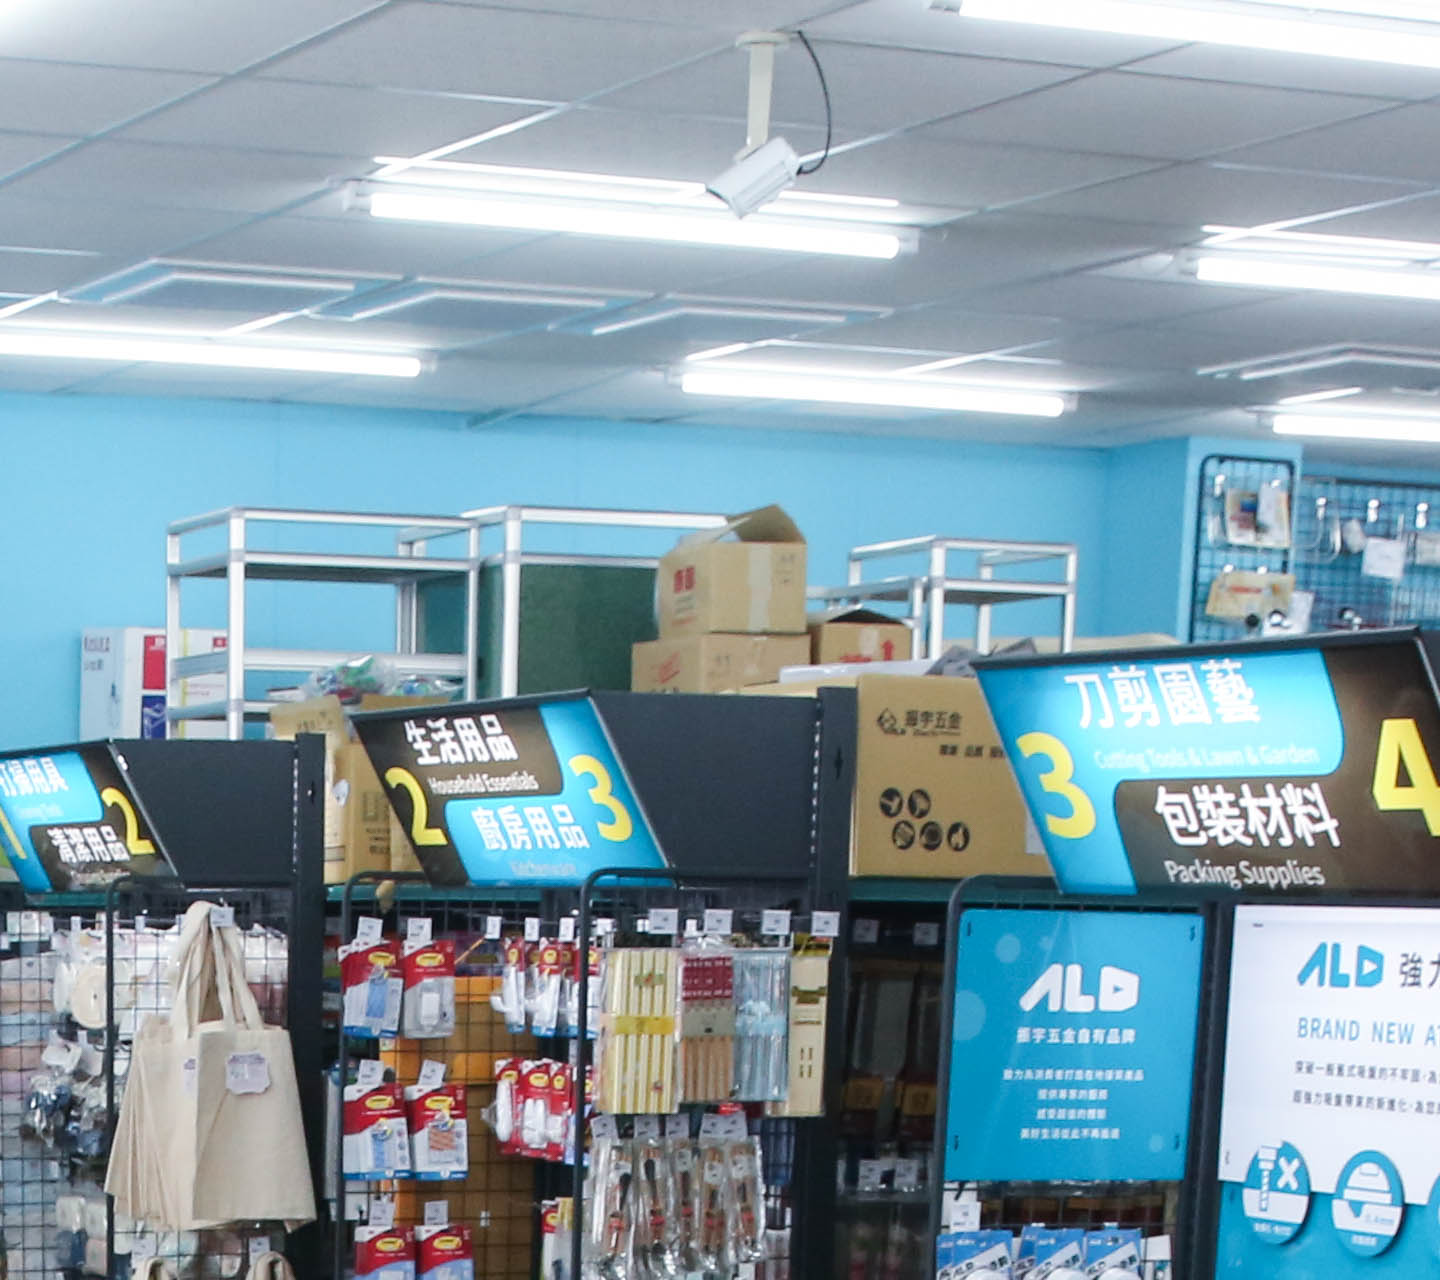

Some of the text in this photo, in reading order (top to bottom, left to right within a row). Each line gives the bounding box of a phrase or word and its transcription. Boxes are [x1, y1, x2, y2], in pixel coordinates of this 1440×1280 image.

[1064, 658, 1262, 731] 刀剪園藝
[404, 713, 519, 766] 生活用品
[384, 767, 449, 846] 2
[427, 770, 540, 795] Household Essentials
[568, 754, 633, 843] 3
[1016, 731, 1097, 840] 3
[101, 786, 156, 855] 2
[472, 804, 590, 851] 廚房用品
[1154, 781, 1343, 852] 包裝材料
[1164, 858, 1327, 890] Packing Supplies
[1019, 963, 1141, 1013] ALD
[1297, 941, 1384, 989] ALD
[1297, 1017, 1361, 1042] BRAND
[1372, 1020, 1416, 1045] NEW
